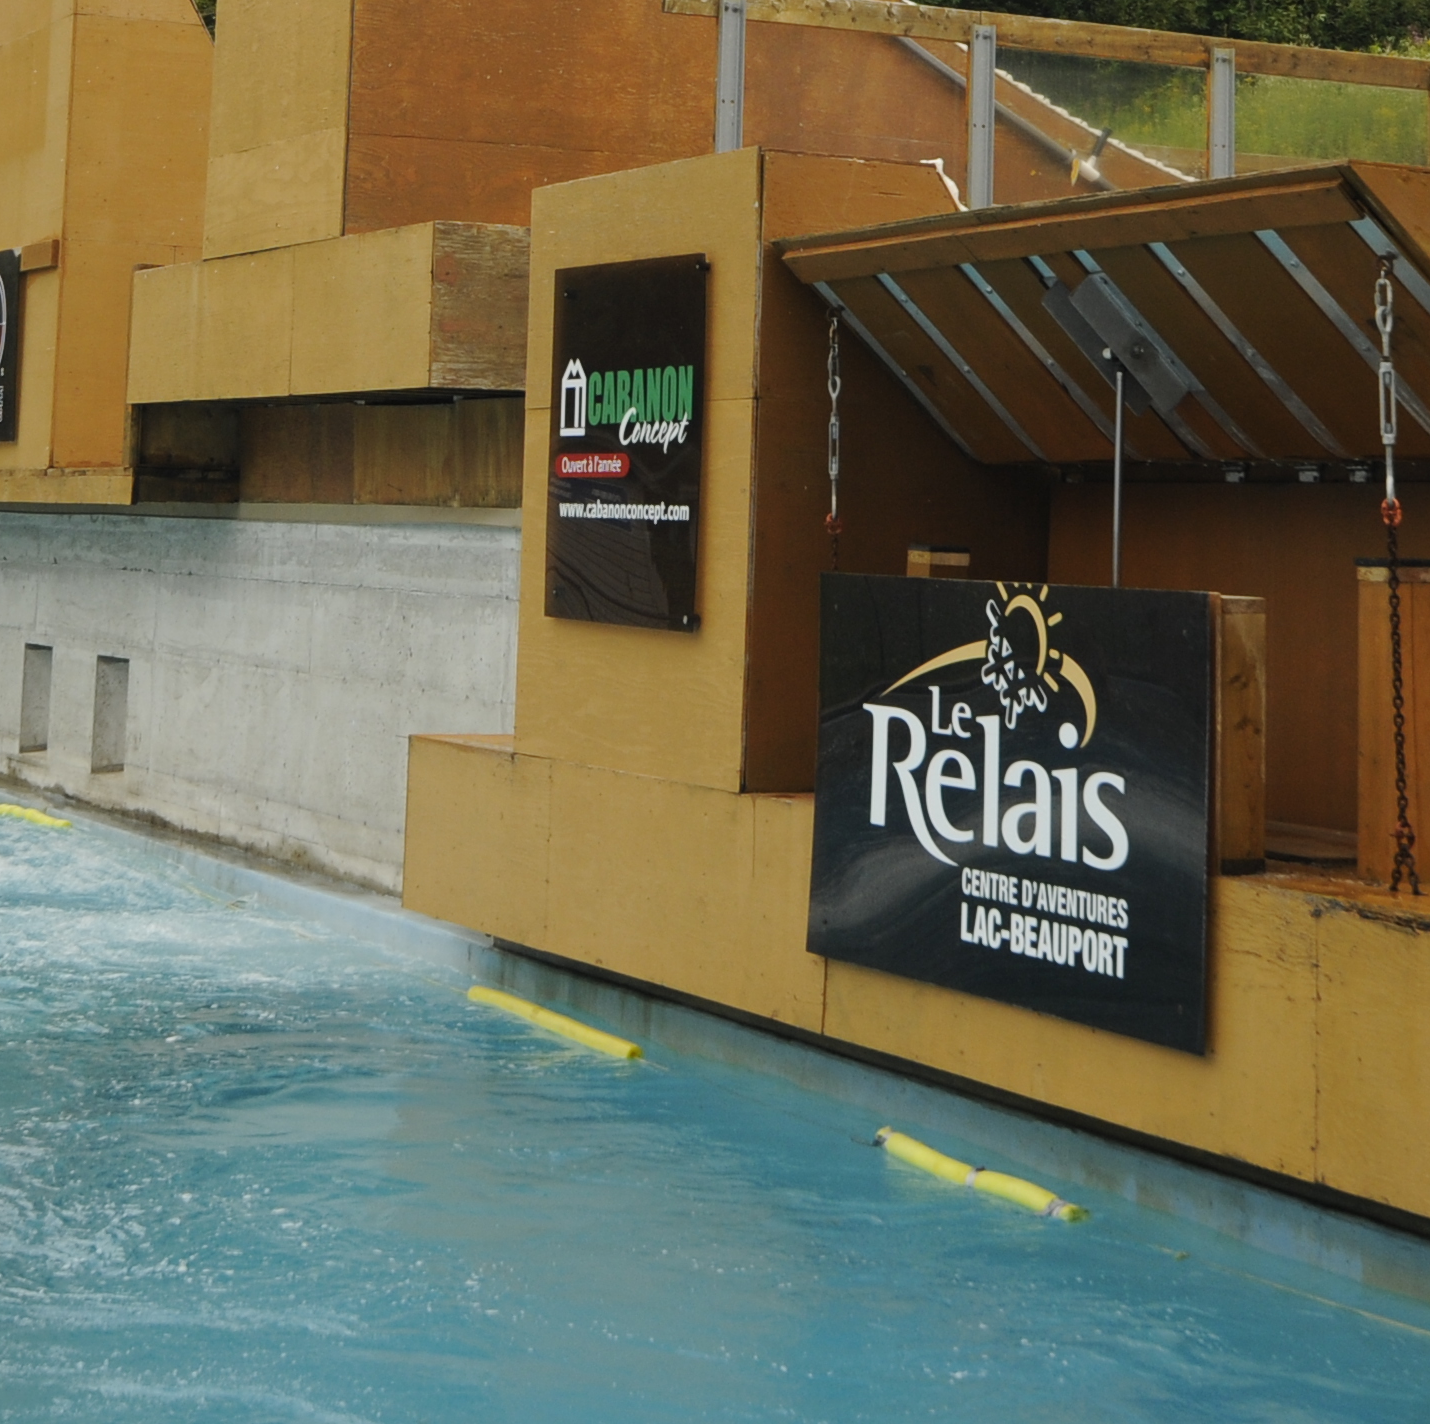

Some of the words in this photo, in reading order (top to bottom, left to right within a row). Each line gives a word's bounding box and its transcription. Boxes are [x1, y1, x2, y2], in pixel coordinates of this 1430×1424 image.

[588, 365, 693, 426] CABANON
[619, 406, 689, 454] Concept
[561, 456, 587, 474] Ouvert
[594, 455, 622, 473] l'année
[559, 499, 690, 525] www.cabanonconcept.com
[928, 685, 972, 738] Le
[862, 702, 1129, 871] Relais
[961, 866, 1019, 906] CENTRE
[1022, 878, 1129, 929] D'AVENTURES
[960, 902, 1129, 979] LAC-BEAUPORT
